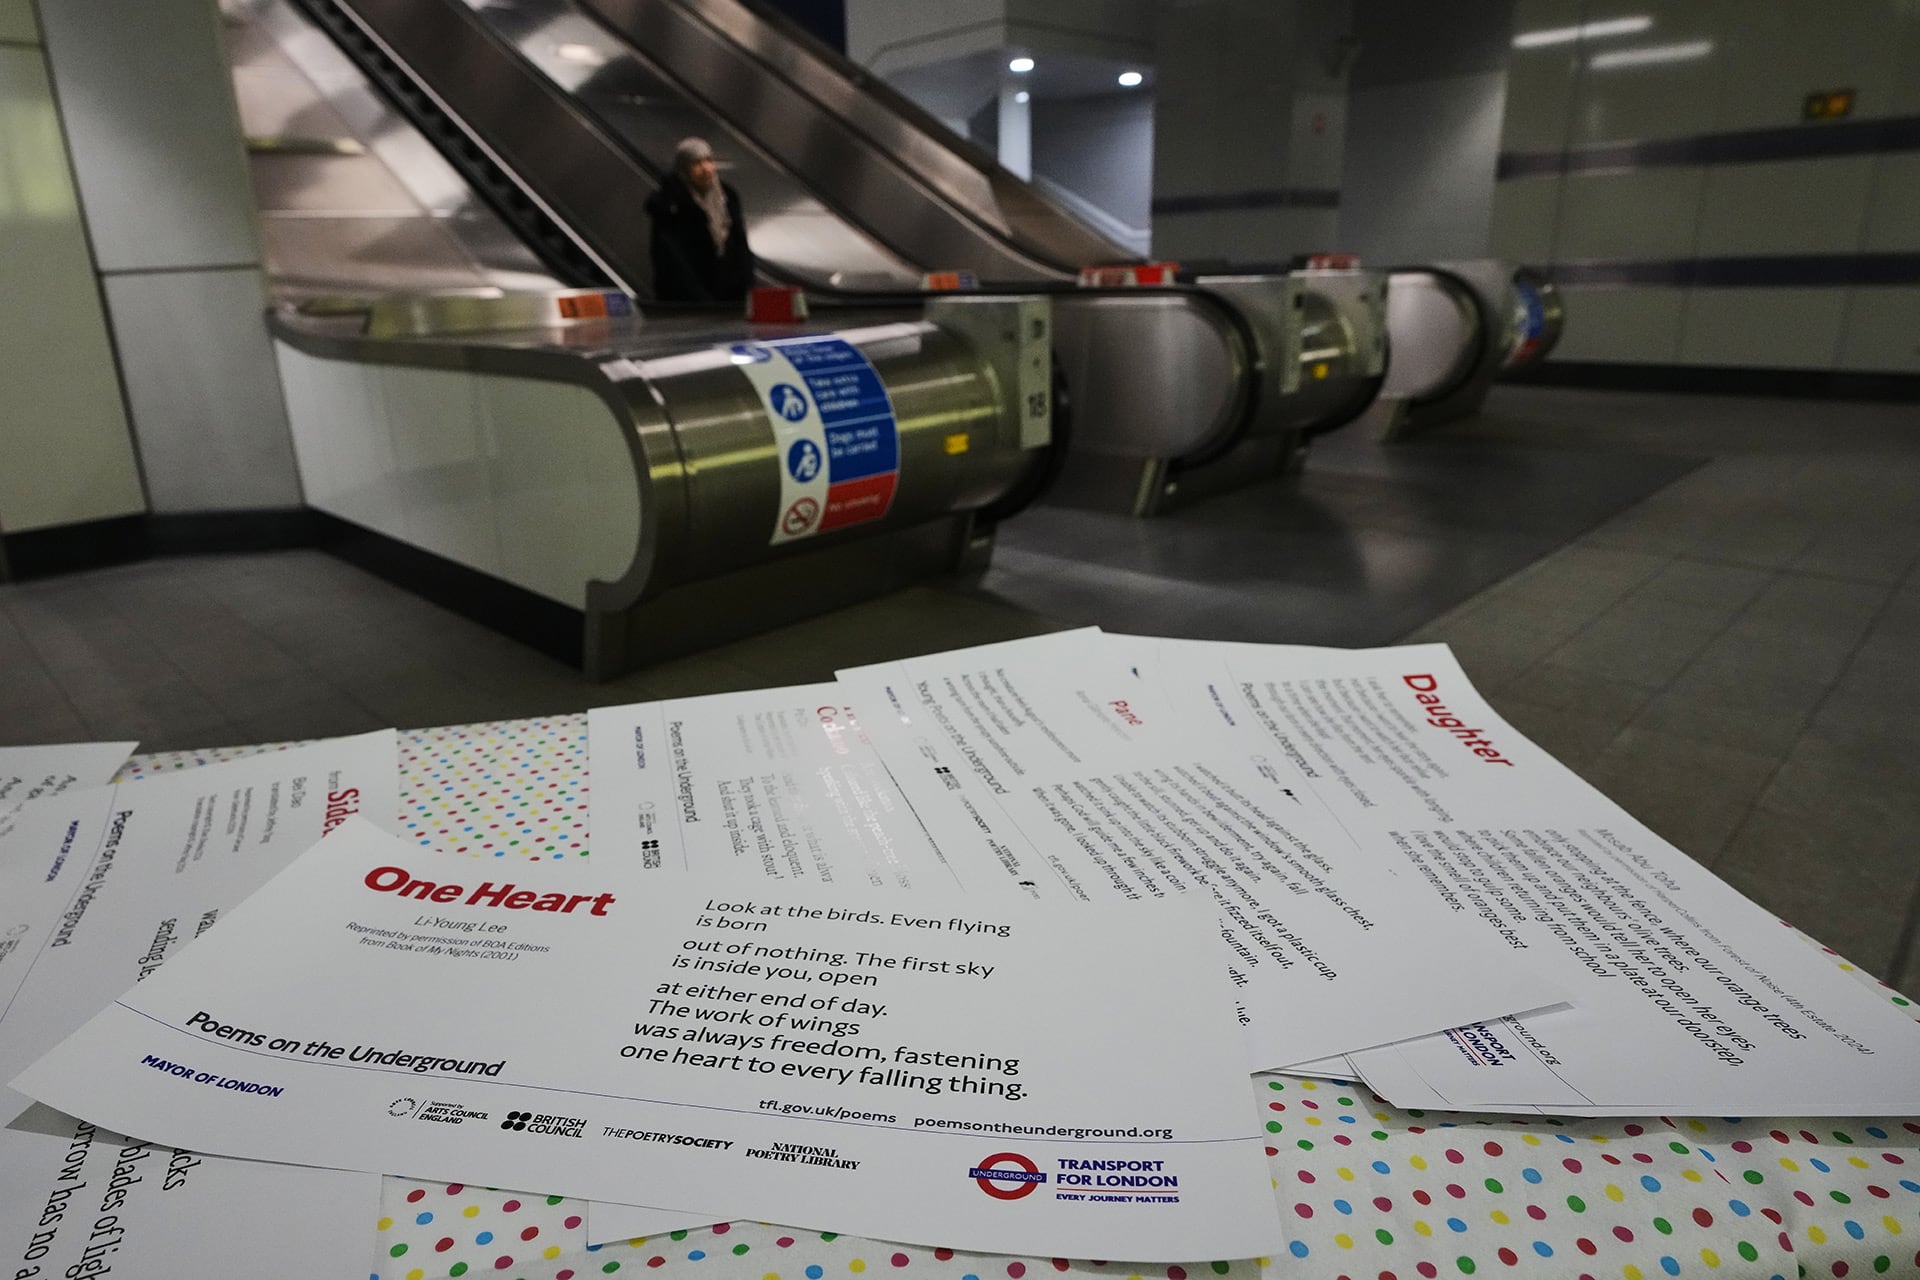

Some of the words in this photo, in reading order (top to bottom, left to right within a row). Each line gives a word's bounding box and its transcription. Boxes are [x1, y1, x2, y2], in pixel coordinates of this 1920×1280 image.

[1402, 674, 1515, 767] Daughter
[364, 866, 464, 902] One
[465, 882, 616, 916] Heart
[1417, 864, 1464, 912] remembers.
[52, 880, 106, 947] Underground
[414, 916, 476, 932] Li-Young
[479, 921, 508, 933] Lee
[696, 913, 712, 928] is
[717, 915, 767, 932] born
[705, 899, 756, 915] Look
[761, 904, 783, 916] at
[788, 905, 822, 919] the
[828, 907, 885, 925] birds.
[891, 913, 941, 930] Even
[949, 917, 1011, 937] flying
[1314, 886, 1347, 906] glass
[1342, 906, 1374, 930] chest,
[1467, 893, 1507, 928] oranges
[1499, 929, 1528, 949] best
[1495, 897, 1526, 923] some.
[138, 918, 177, 966] sending
[346, 921, 398, 939] Reprinted
[400, 932, 410, 941] by
[410, 934, 468, 946] permission
[470, 938, 482, 947] of
[508, 942, 550, 952] Editions
[360, 937, 386, 948] from
[480, 950, 519, 961] (2001)
[1224, 905, 1259, 930] fizzed
[1248, 929, 1283, 950] itself
[1270, 951, 1294, 969] out,
[1546, 923, 1577, 945] from
[1569, 946, 1616, 977] school
[1627, 923, 1660, 945] olive
[1653, 946, 1689, 973] trees.
[673, 954, 688, 968] is
[694, 956, 760, 976] inside
[765, 965, 813, 982] you,
[819, 969, 878, 987] open
[683, 938, 723, 954] out
[729, 940, 754, 957] of
[759, 944, 848, 966] nothing.
[856, 951, 897, 968] The
[903, 955, 950, 973] first
[956, 961, 995, 979] sky
[1278, 933, 1319, 961] plastic
[1313, 961, 1337, 981] cup,
[1545, 901, 1576, 916] put
[1567, 917, 1600, 941] them
[1607, 961, 1648, 986] plate
[1641, 987, 1664, 997] at
[1654, 999, 1685, 1017] our
[1676, 1018, 1743, 1066] doorstep,
[1580, 903, 1622, 931] would
[1610, 932, 1640, 947] tell
[1627, 949, 1655, 965] her
[1647, 966, 1666, 976] to
[1660, 978, 1698, 1004] open
[1691, 1006, 1724, 1024] her
[1715, 1025, 1755, 1051] eyes,
[1659, 926, 1700, 956] where
[1694, 957, 1723, 974] our
[1716, 976, 1768, 1012] orange
[1762, 1013, 1806, 1039] trees
[648, 999, 690, 1018] The
[696, 1005, 753, 1026] work
[759, 1012, 787, 1028] of
[791, 1016, 859, 1036] wings
[657, 981, 681, 995] at
[686, 983, 757, 1003] either
[762, 989, 805, 1009] end
[811, 995, 838, 1011] of
[841, 997, 888, 1018] day.
[186, 1010, 266, 1046] Poems
[269, 1037, 300, 1053] on
[308, 1040, 345, 1060] the
[349, 1046, 506, 1077] Underground
[634, 1022, 678, 1040] was
[683, 1025, 765, 1051] always
[771, 1034, 886, 1063] freedom,
[895, 1046, 1019, 1075] fastening
[1458, 1027, 1504, 1066] LONDON
[141, 1054, 193, 1079] MAYOR
[195, 1072, 217, 1085] OF
[215, 1077, 285, 1098] LONDON
[620, 1043, 668, 1063] one
[673, 1047, 743, 1072] heart
[748, 1055, 775, 1075] to
[781, 1061, 853, 1085] every
[859, 1066, 942, 1095] falling
[949, 1075, 1028, 1100] thing.
[418, 1114, 463, 1125] ENGLAND
[425, 1106, 448, 1116] ARTS
[450, 1108, 489, 1120] COUNCIL
[527, 1123, 584, 1138] COUNCIL
[533, 1114, 587, 1128] BRITISH
[758, 1099, 897, 1124] tfl.gov.uk/poems
[914, 1116, 1173, 1139] poemsontheunderground.org
[745, 1148, 799, 1164] POETRY
[800, 1154, 860, 1170] LIBRARY
[771, 1142, 839, 1159] NATIONAL
[1058, 1158, 1164, 1172] TRANSPORT
[100, 1142, 154, 1212] blades
[972, 1169, 1043, 1182] UNDERGROUND
[1056, 1174, 1092, 1185] FOR
[1096, 1175, 1178, 1187] LONDON
[39, 1181, 87, 1227] has
[1056, 1193, 1086, 1202] EVERY
[1088, 1194, 1133, 1202] JOURNEY
[24, 1227, 58, 1261] no
[89, 1215, 125, 1241] of
